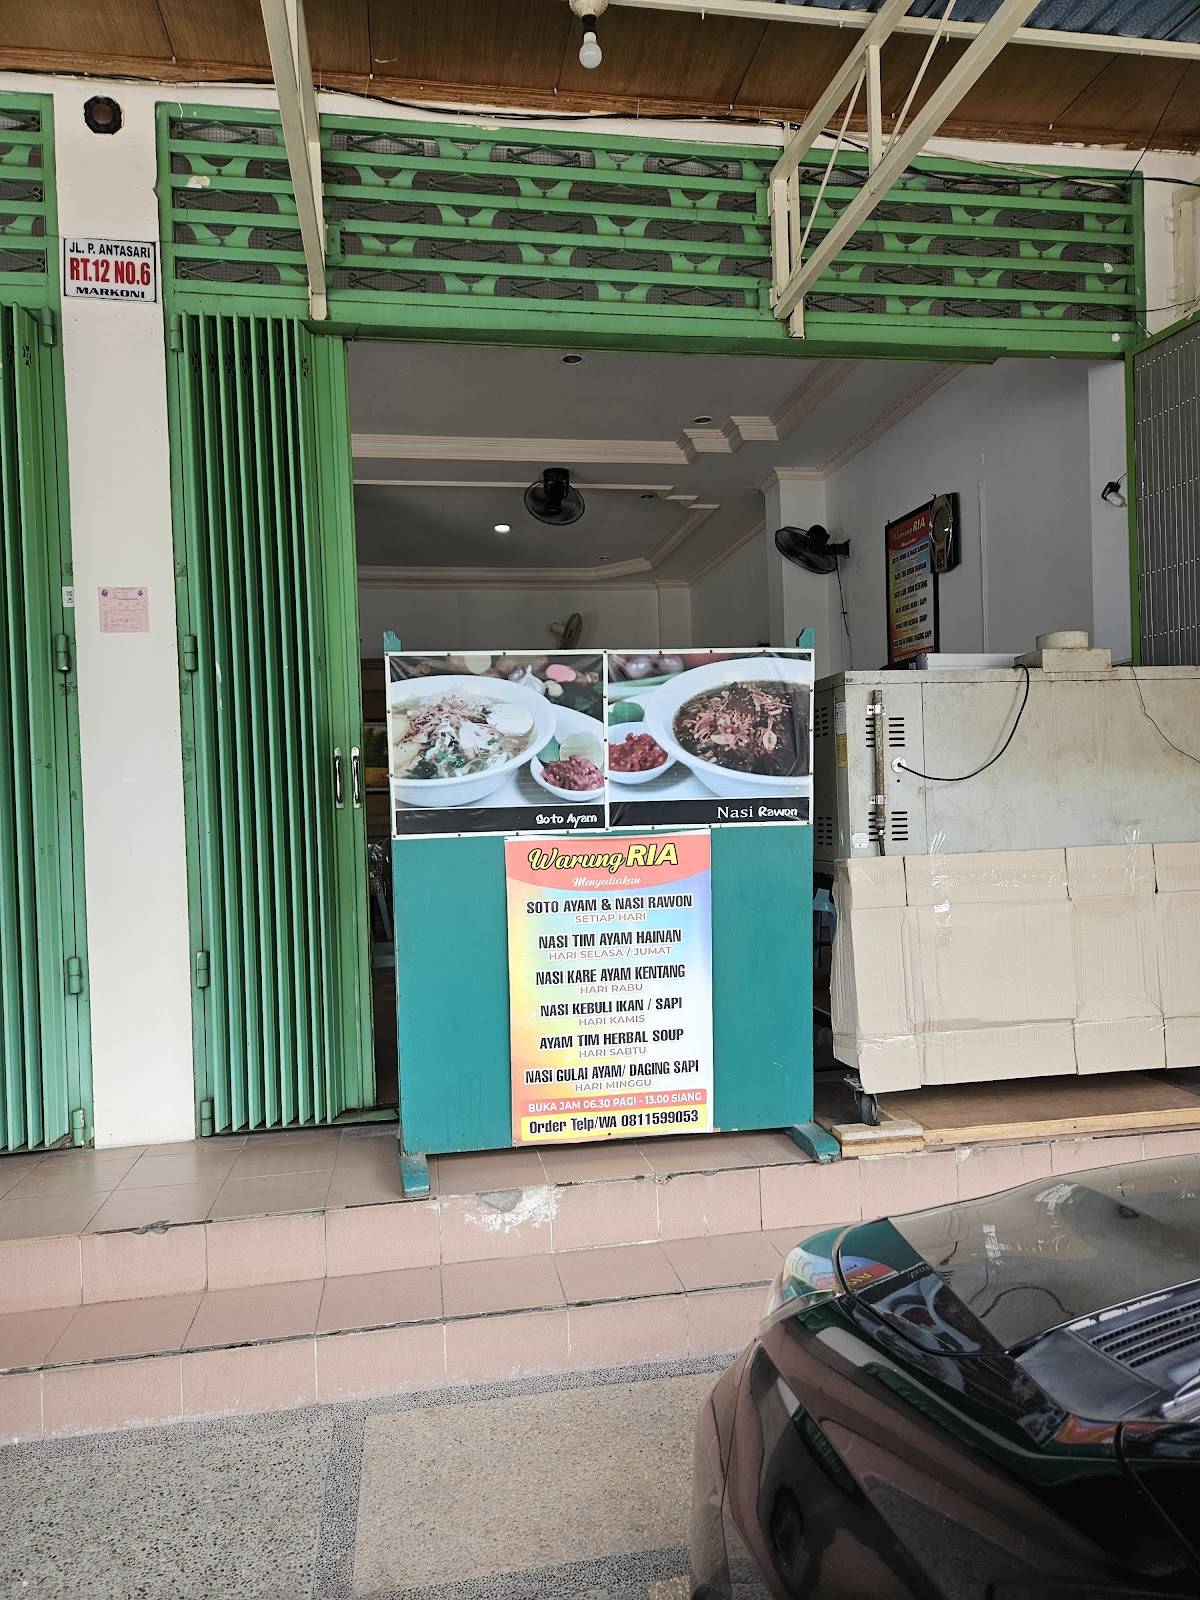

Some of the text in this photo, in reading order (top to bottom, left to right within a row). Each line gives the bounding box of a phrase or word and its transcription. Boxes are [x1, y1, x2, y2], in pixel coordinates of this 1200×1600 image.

[70, 242, 150, 258] JL. P. ANTASARI
[70, 257, 151, 286] RT.12 NO.6
[76, 286, 145, 298] MARKONI
[717, 806, 798, 819] Nasi Rawon
[536, 813, 598, 829] Soto Ayam
[528, 843, 678, 874] Warung RIA
[572, 876, 640, 888] Menyediakan
[526, 895, 693, 914] SOTO AYAM & NASI RAWON
[575, 912, 646, 923] SETIAP HARI
[538, 929, 682, 949] NASI TIM AYAM HAINAN
[549, 951, 576, 960] HARI
[580, 950, 624, 959] SELASA
[633, 946, 672, 956] JUMAT
[536, 964, 685, 986] NASI KARE AYAM KENTANG
[580, 983, 643, 994] HARI RABU
[540, 997, 682, 1017] NASI KEBULI IKAN / SAPI
[579, 1015, 645, 1026] HARI KAMIS
[540, 1028, 684, 1050] AYAM TIM HERBAL SOUP
[579, 1047, 646, 1058] HARI SABTU
[525, 1069, 552, 1084] NASI
[556, 1067, 588, 1082] GULAI
[629, 1061, 670, 1076] DAGING
[673, 1059, 699, 1073] SAPI
[575, 1079, 652, 1092] HARI MINGGU
[528, 1103, 557, 1113] BUKA
[559, 1101, 580, 1111] JAM
[584, 1099, 610, 1109] 06.30
[613, 1097, 636, 1106] PAGI
[645, 1094, 669, 1104] 13.00
[671, 1092, 702, 1102] SIANG
[529, 1110, 699, 1134] Order Telp/WA 0811599053
